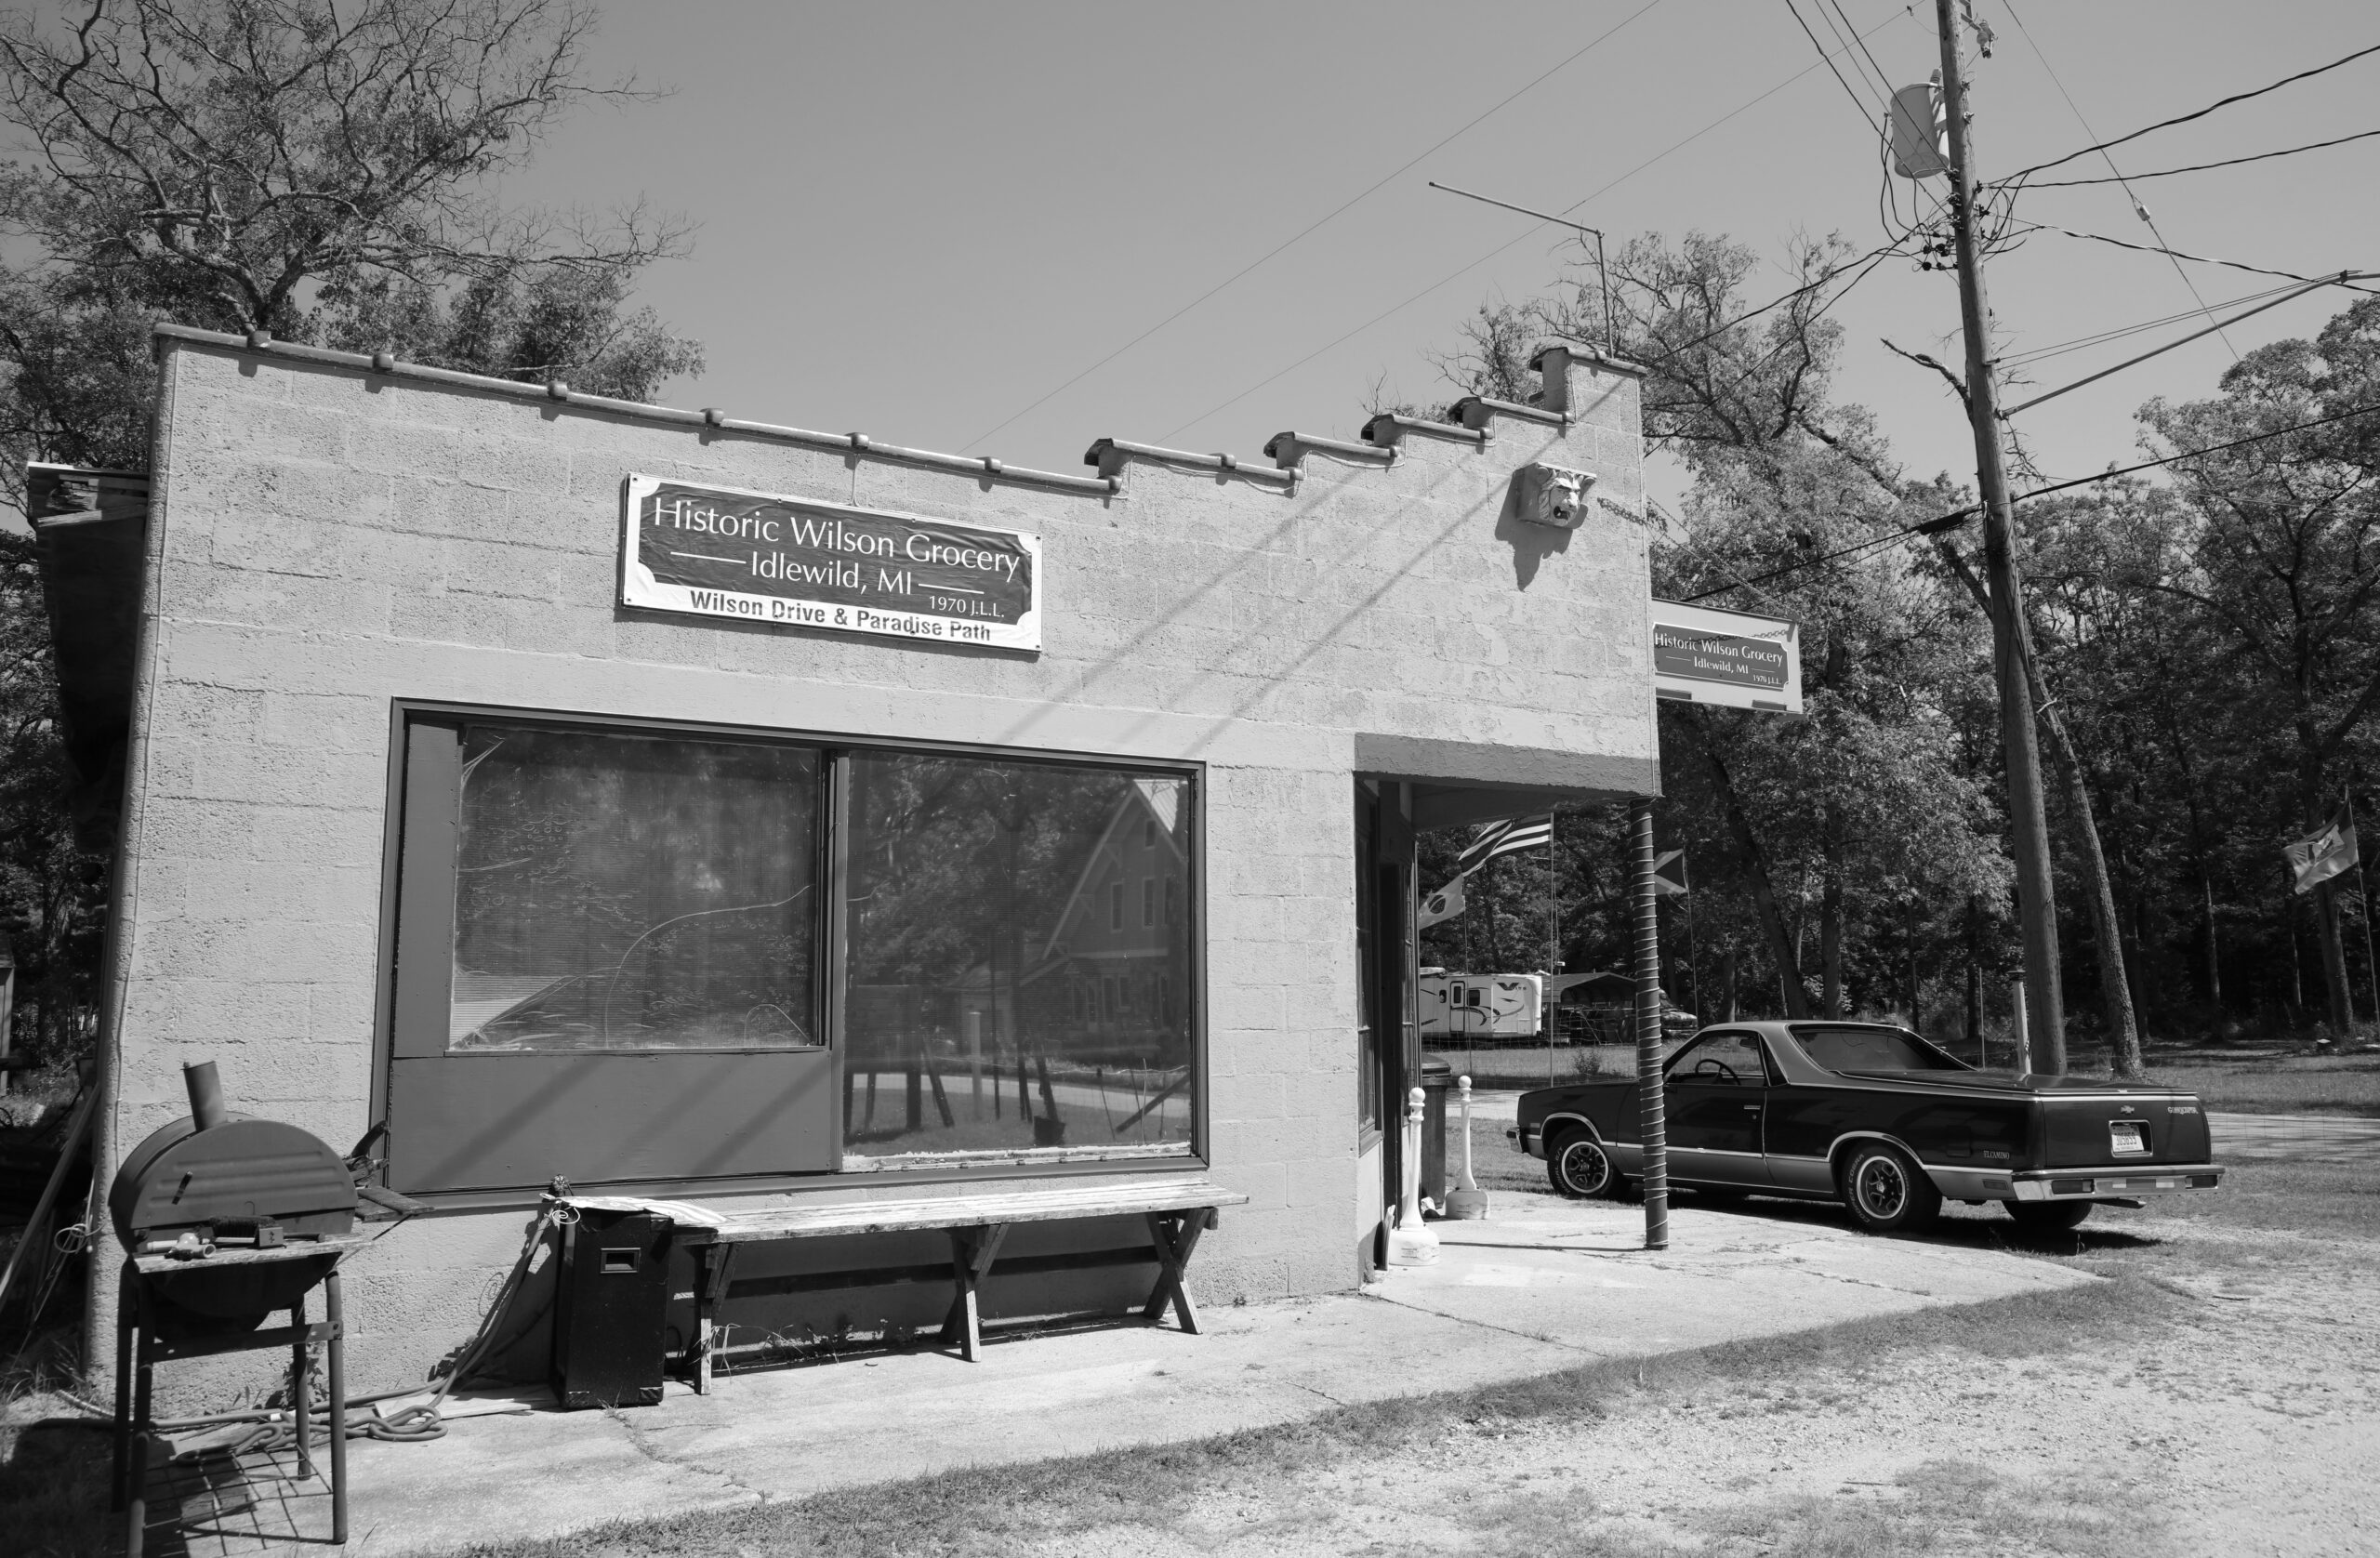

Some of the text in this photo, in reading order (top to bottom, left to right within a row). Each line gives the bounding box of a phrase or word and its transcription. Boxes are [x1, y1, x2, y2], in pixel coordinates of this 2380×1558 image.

[654, 497, 1020, 583] Historic Wilson Grocery
[751, 551, 911, 596] Idlewild, MI
[690, 590, 991, 642] Wilson Drive & Paradise Path
[929, 595, 1005, 618] 1970 J.L.L.
[1655, 632, 1783, 667] Historic Wilson Grocery
[1694, 655, 1749, 674] Idlewild, MI
